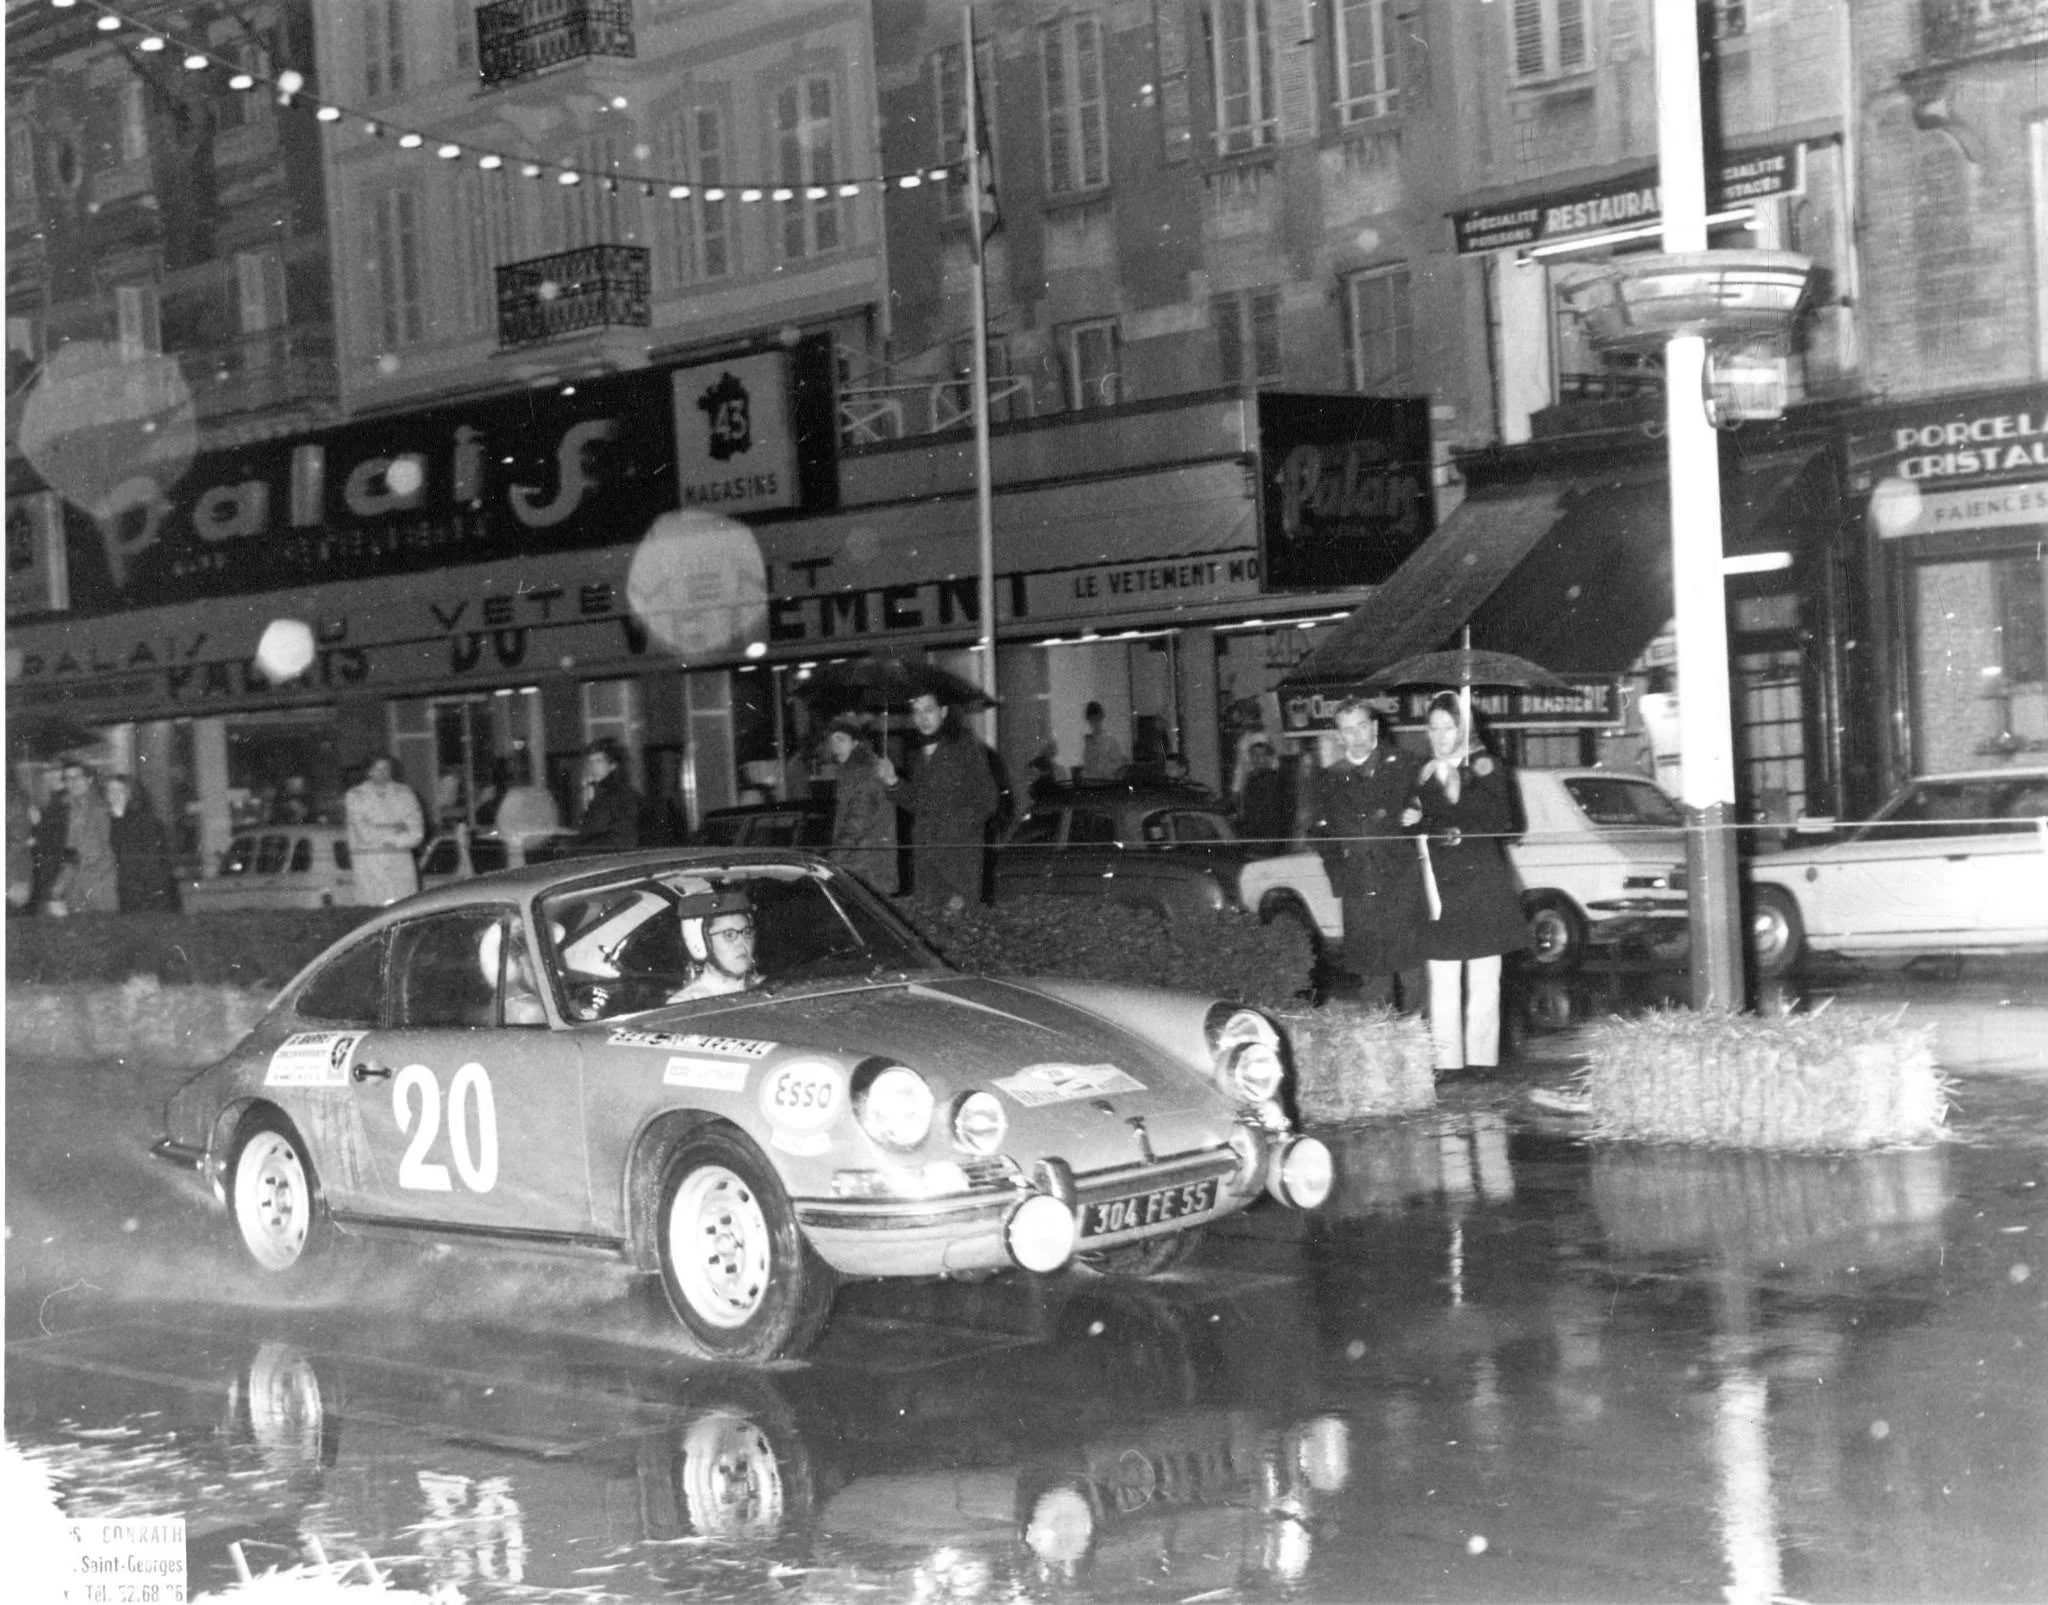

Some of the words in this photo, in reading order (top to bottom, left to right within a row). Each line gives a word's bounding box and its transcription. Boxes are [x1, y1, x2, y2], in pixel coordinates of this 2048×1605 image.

[1546, 186, 1662, 233] RESTAURA
[715, 399, 747, 440] 43
[427, 556, 833, 630] VETEENT
[1074, 574, 1099, 599] LE
[1107, 562, 1216, 594] VETEMENT
[167, 648, 368, 702] PALIS
[392, 1061, 499, 1194] 20
[1094, 1198, 1138, 1234] 304
[1146, 1191, 1176, 1223] FE
[1181, 1182, 1209, 1214] 55
